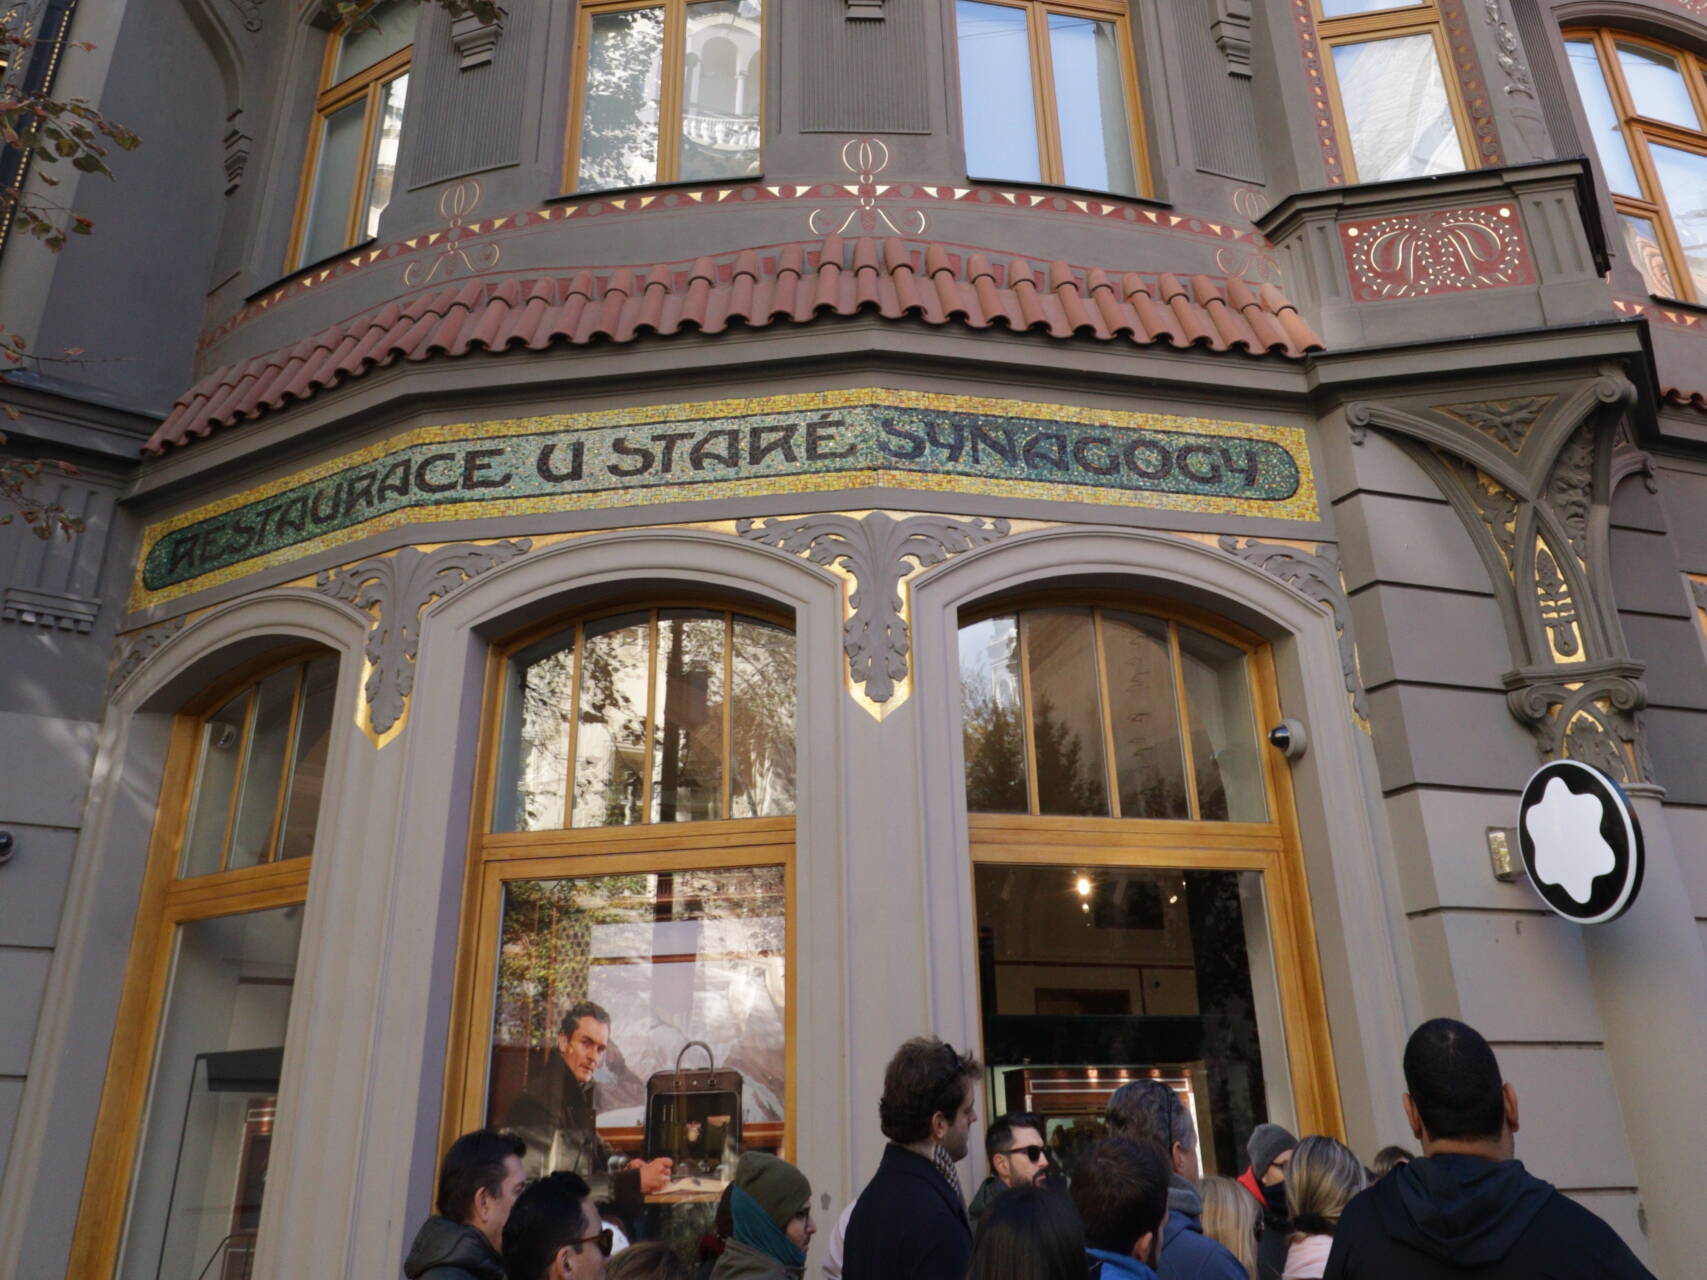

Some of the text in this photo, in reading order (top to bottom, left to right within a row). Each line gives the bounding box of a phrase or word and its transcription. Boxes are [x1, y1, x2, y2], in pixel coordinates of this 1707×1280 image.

[168, 412, 1257, 573] RESTAURACE U STARÉ SYNAGOGY
